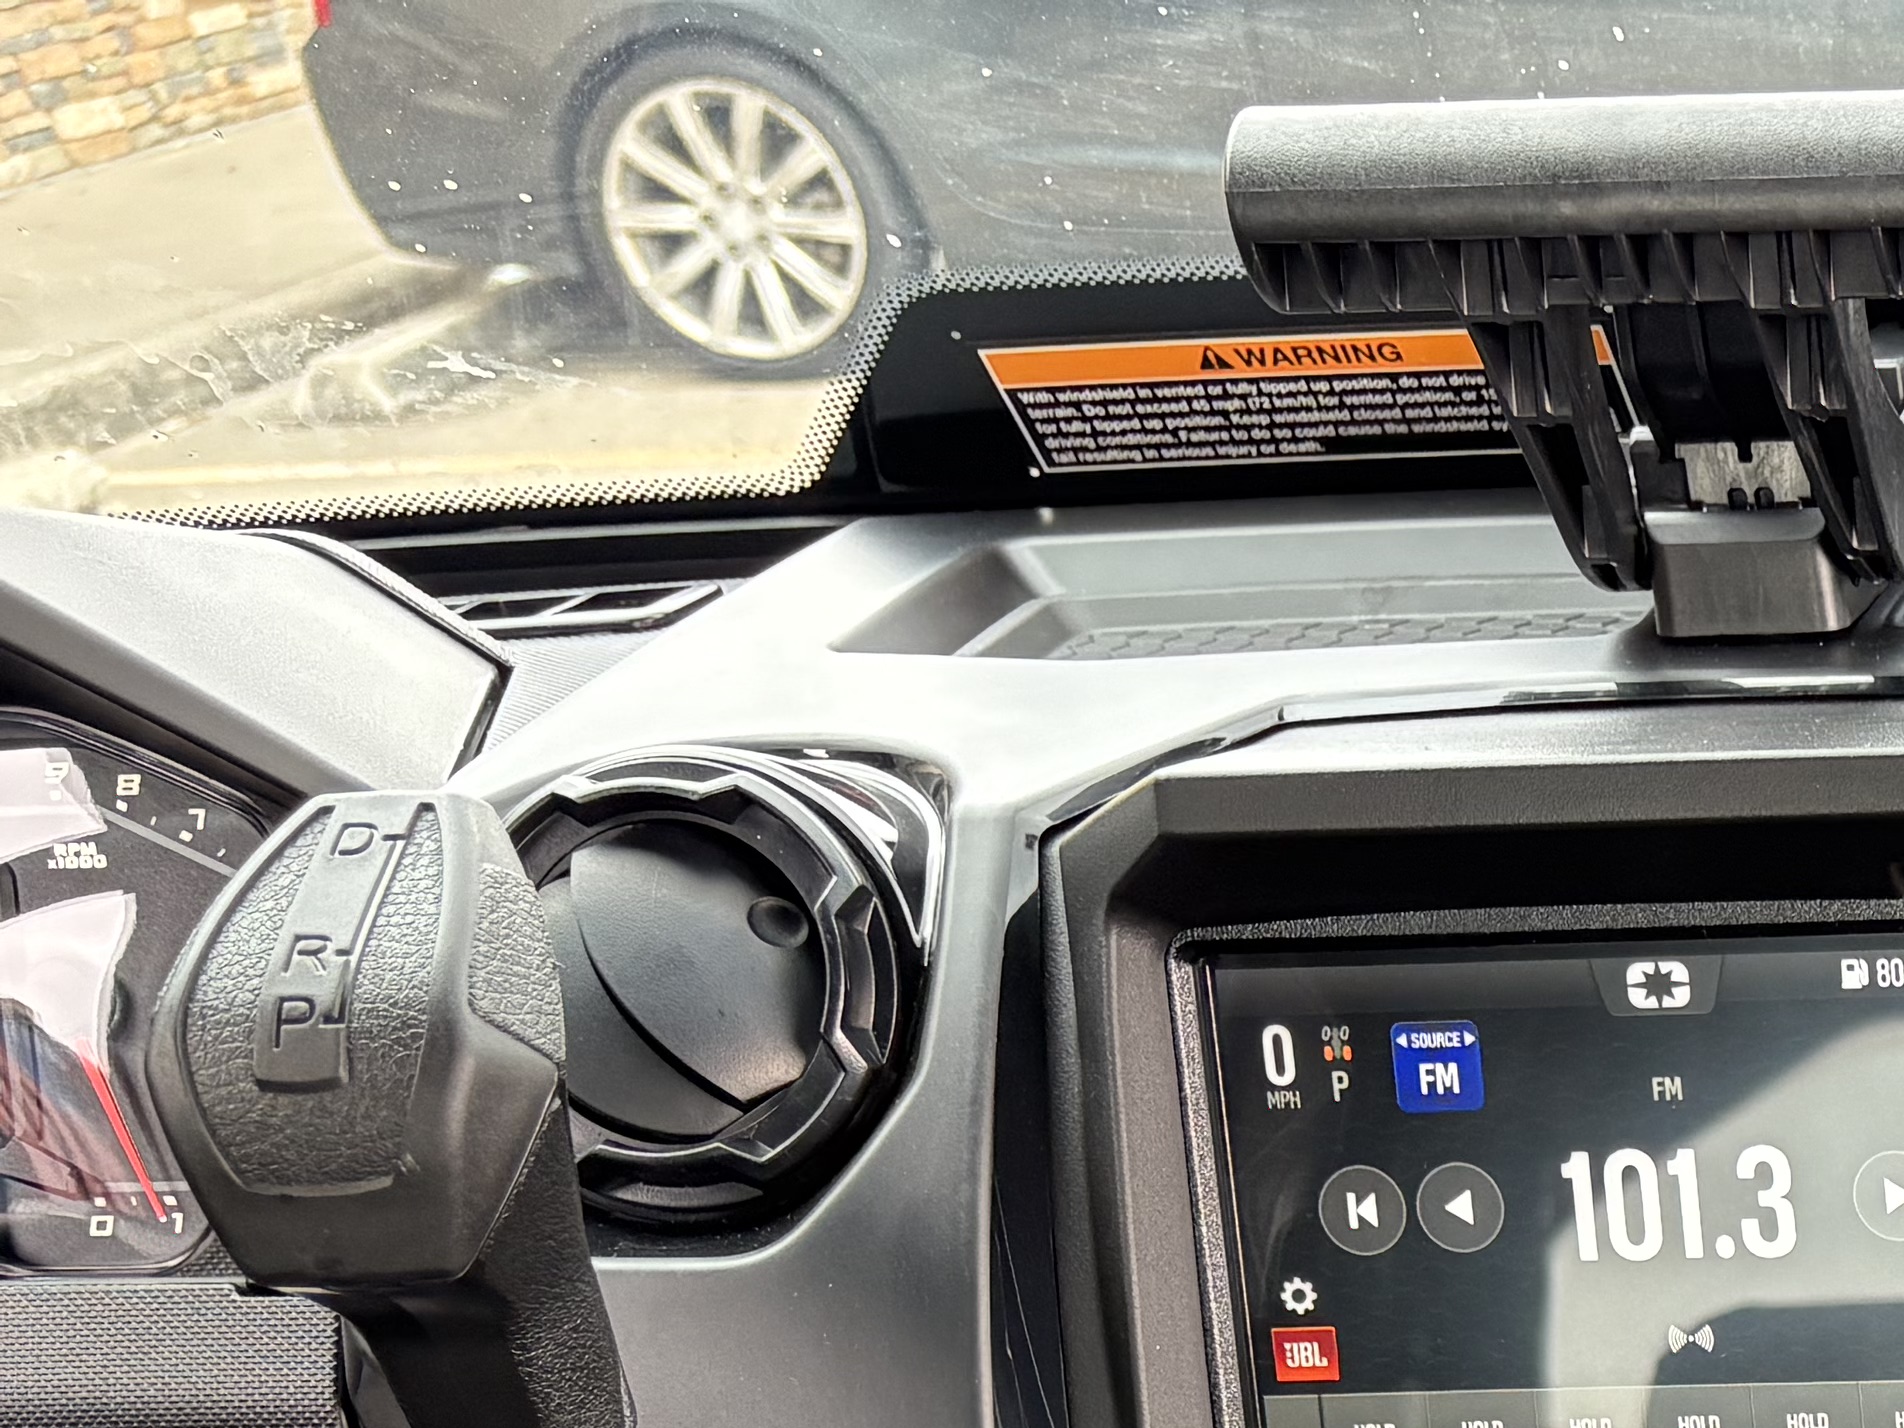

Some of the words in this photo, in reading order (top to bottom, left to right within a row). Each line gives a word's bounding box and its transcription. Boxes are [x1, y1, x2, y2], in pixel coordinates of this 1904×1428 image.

[1234, 341, 1404, 368] WARNING
[1016, 390, 1055, 405] With
[1054, 386, 1136, 403] windshield
[1135, 386, 1154, 399] in
[1153, 384, 1206, 399] vented
[1206, 386, 1224, 396] or
[1224, 382, 1258, 397] fully
[1258, 379, 1309, 396] tipped
[1309, 381, 1331, 394] up
[1331, 377, 1398, 393] position,
[1397, 375, 1420, 389] do
[1420, 374, 1448, 388] not
[1448, 373, 1487, 387] drive
[116, 774, 141, 796] 8
[188, 808, 206, 831] 7
[53, 842, 98, 856] RPM
[331, 823, 377, 857] D
[281, 935, 332, 976] R
[276, 997, 314, 1050] P
[1411, 1032, 1461, 1048] SOURCE
[1262, 1025, 1295, 1086] 0
[1332, 1071, 1348, 1101] P
[1419, 1062, 1460, 1095] FM
[1652, 1077, 1683, 1101] FM
[1267, 1091, 1301, 1109] MPH
[1561, 1144, 1798, 1262] 101.3
[90, 1215, 115, 1237] 0
[171, 1212, 184, 1234] 1
[1283, 1342, 1329, 1370] JBL
